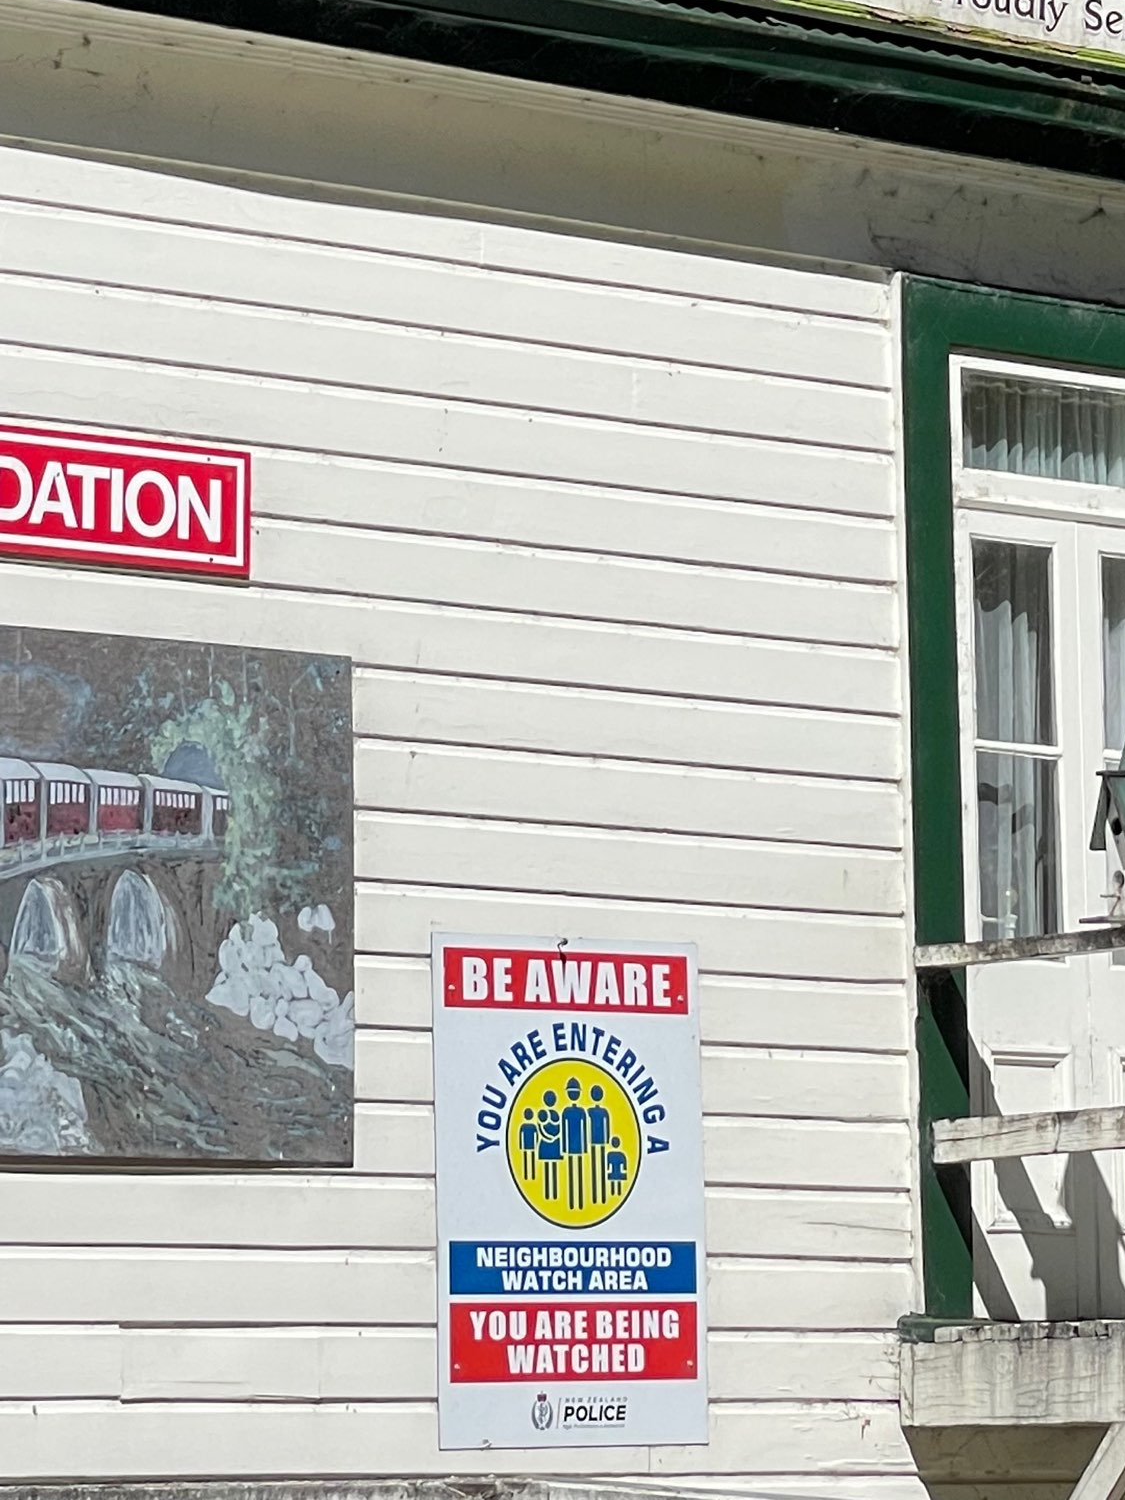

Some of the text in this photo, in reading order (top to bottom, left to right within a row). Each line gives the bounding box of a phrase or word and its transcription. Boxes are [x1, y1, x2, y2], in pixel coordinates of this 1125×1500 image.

[0, 456, 223, 543] DATION
[461, 956, 672, 1007] BE AWARE
[476, 1022, 670, 1155] YOU ARE ENTERING A
[476, 1247, 673, 1268] NEIGHBOURHOOD
[501, 1270, 649, 1291] WATCH AREA
[469, 1309, 681, 1341] YOU ARE BEING
[506, 1343, 647, 1375] WATCHED
[563, 1405, 627, 1422] POLICE
